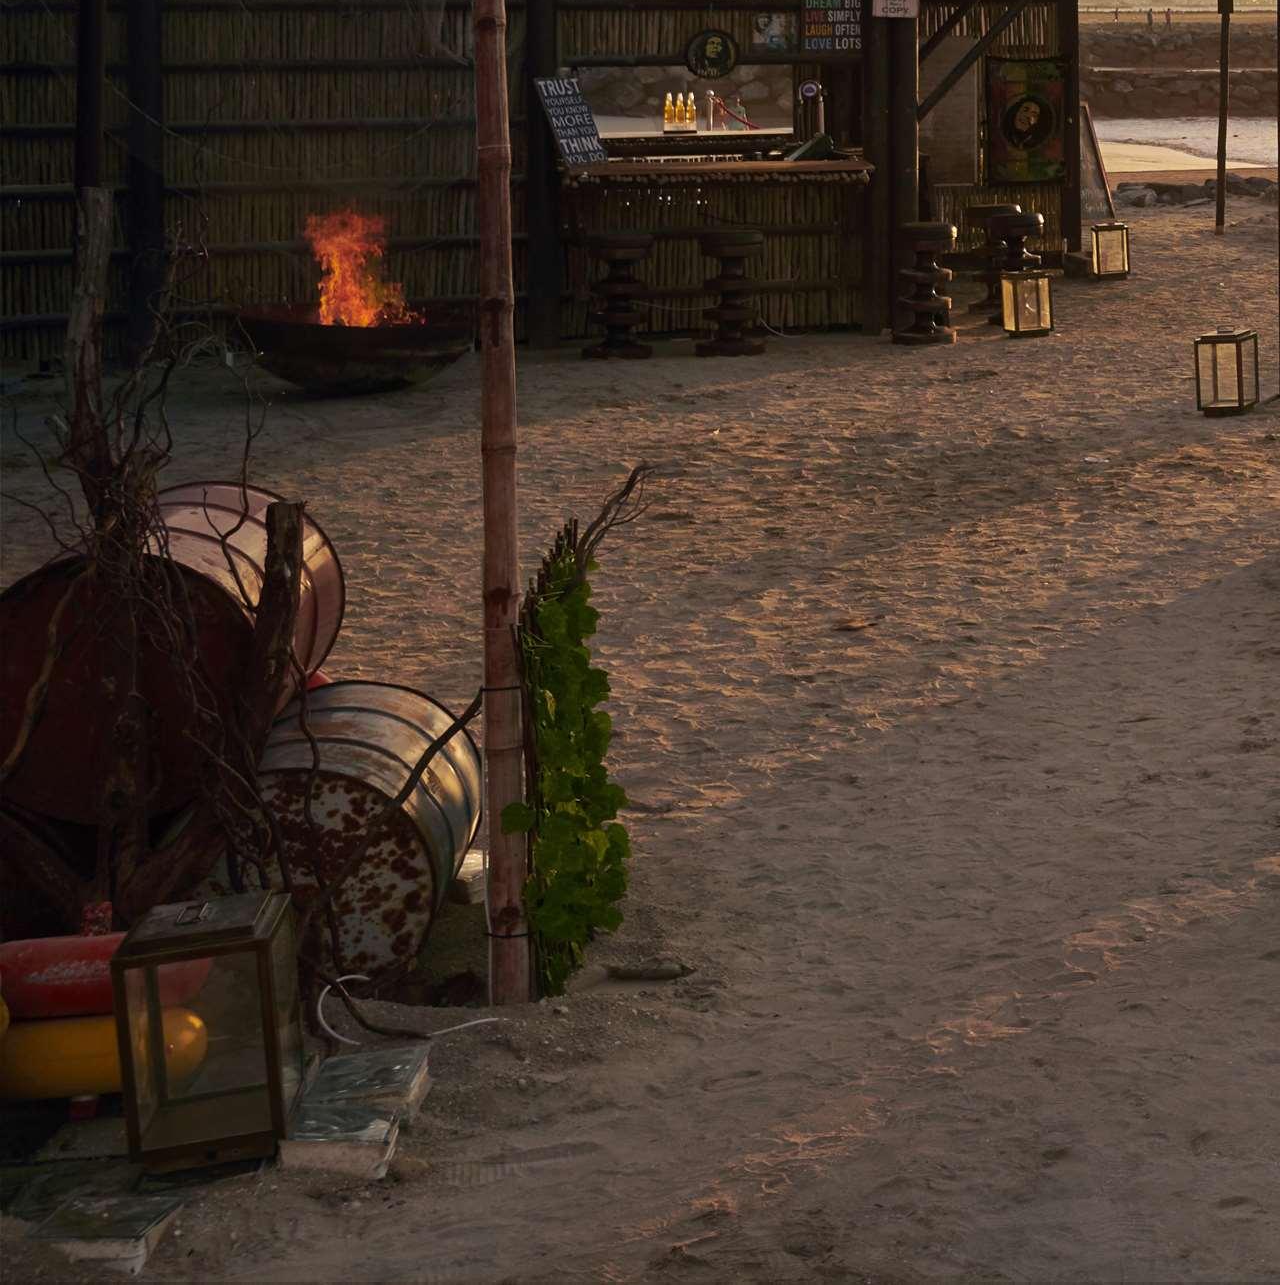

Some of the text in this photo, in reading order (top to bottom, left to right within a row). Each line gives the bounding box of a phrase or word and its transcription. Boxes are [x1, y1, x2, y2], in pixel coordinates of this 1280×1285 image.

[805, 10, 862, 22] LIVE SIMPLY
[805, 24, 861, 35] LAUGH OFTEN
[805, 37, 862, 50] LOVE LOTS
[538, 78, 580, 96] TRUST
[549, 106, 564, 116] YOU
[552, 113, 593, 127] MORE
[579, 124, 597, 135] YOU
[560, 136, 603, 153] THINK
